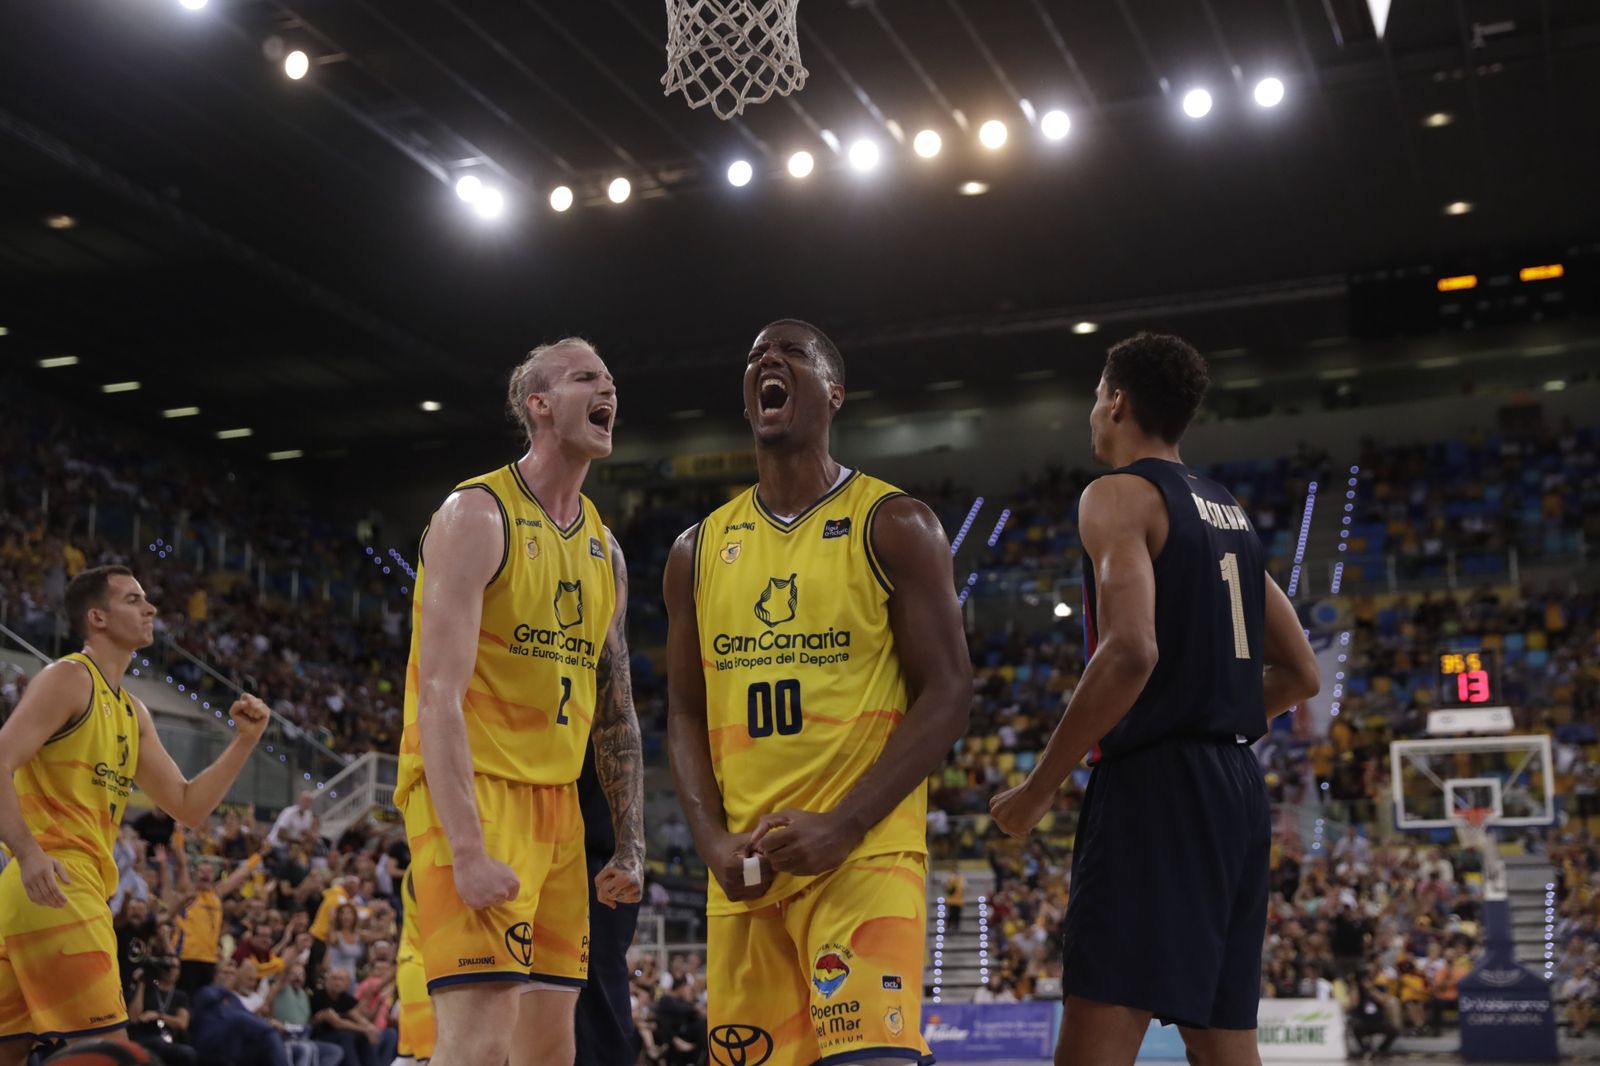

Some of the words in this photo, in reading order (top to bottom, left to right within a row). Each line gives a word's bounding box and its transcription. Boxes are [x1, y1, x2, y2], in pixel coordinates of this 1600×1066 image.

[1219, 552, 1251, 659] 1
[509, 643, 529, 656] Isla
[565, 654, 579, 666] del
[715, 659, 733, 671] Isla
[776, 652, 795, 664] del
[800, 652, 849, 667] Deporte
[1457, 670, 1490, 702] 13
[556, 676, 572, 725] 2
[747, 678, 803, 738] 00
[458, 955, 495, 967] SPALDING
[810, 1000, 860, 1021] Poema
